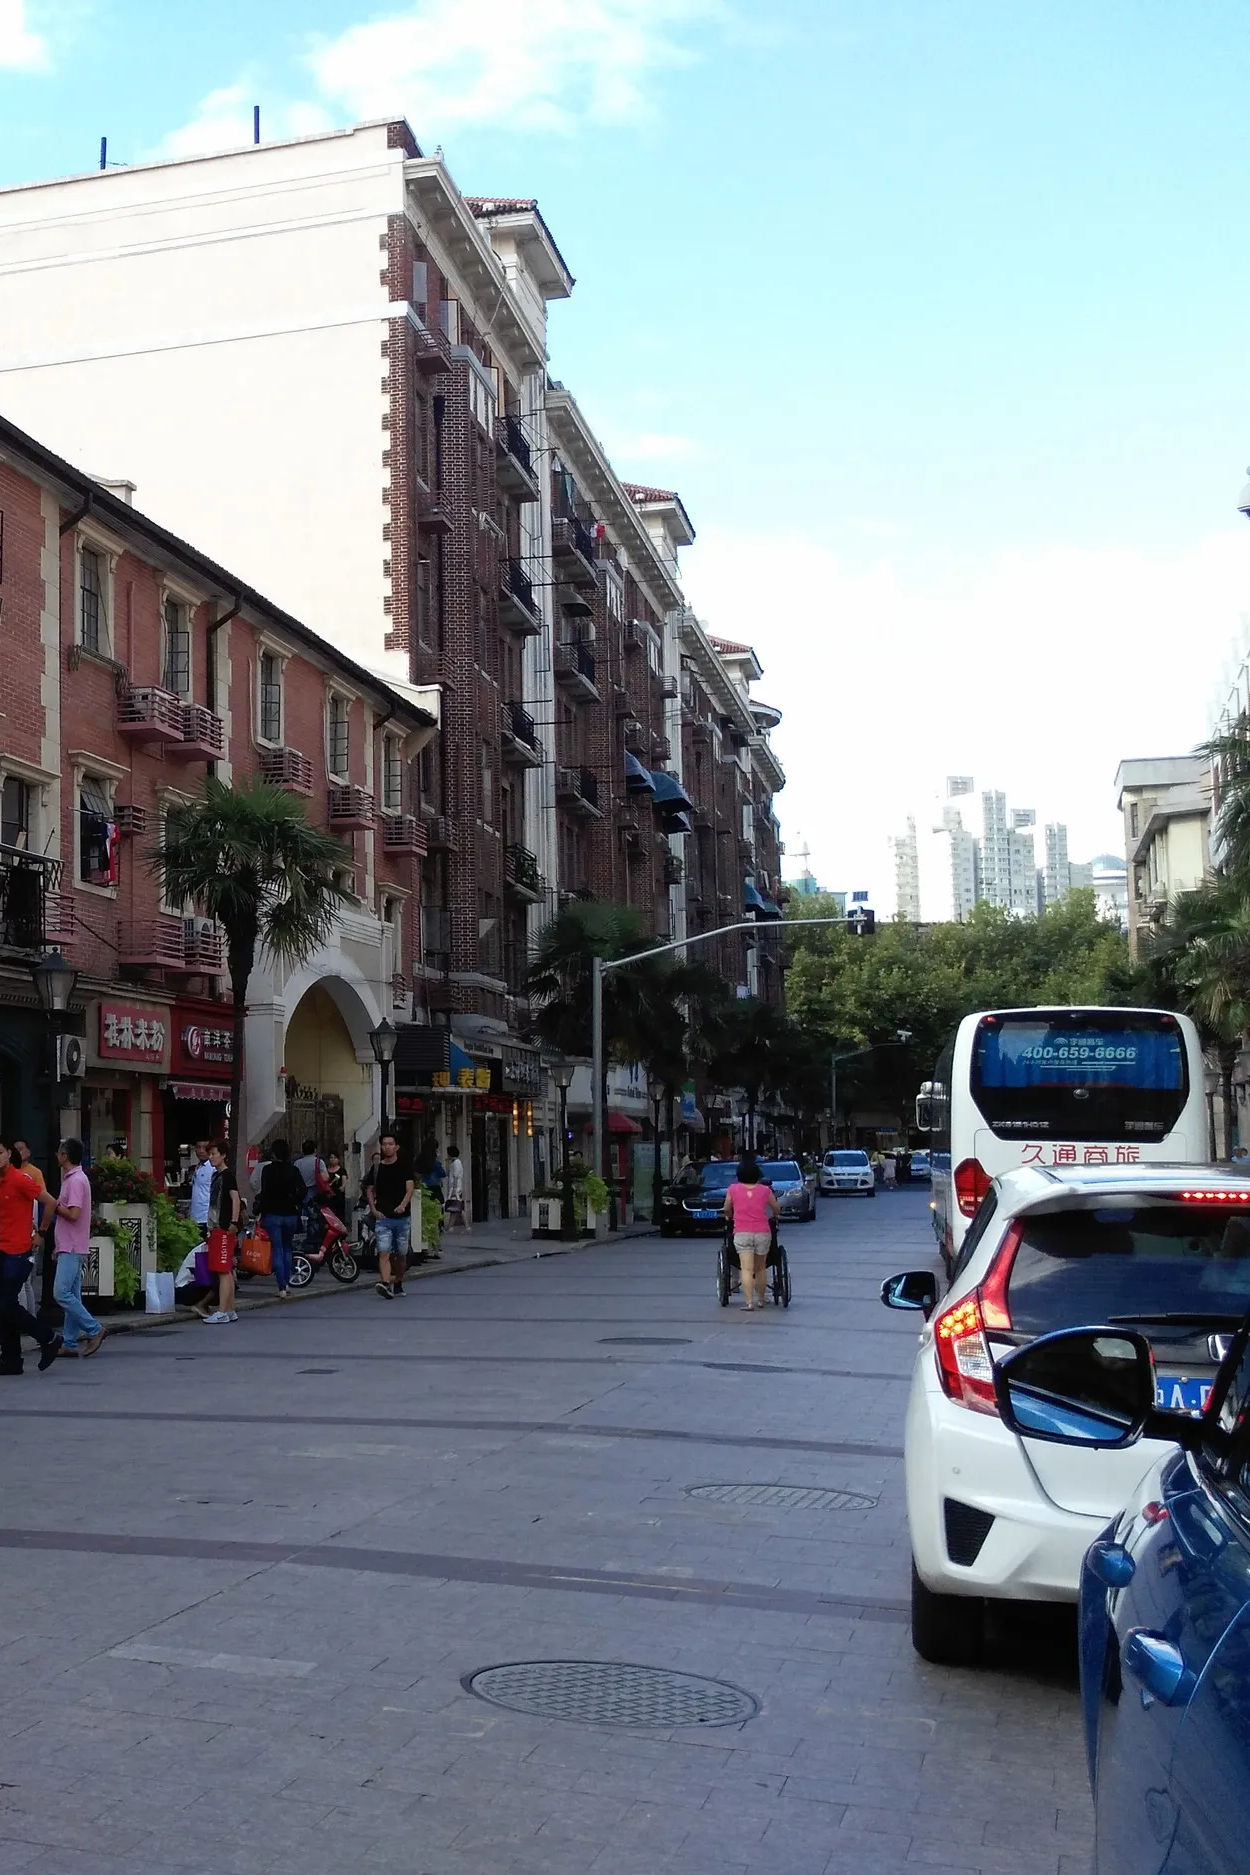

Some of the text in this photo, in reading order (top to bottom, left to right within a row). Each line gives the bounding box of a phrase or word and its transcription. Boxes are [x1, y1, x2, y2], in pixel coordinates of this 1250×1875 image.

[104, 1013, 166, 1052] 桂林米粉
[1022, 1047, 1137, 1059] 400-659-6666
[1021, 1143, 1140, 1166] 久通商旅
